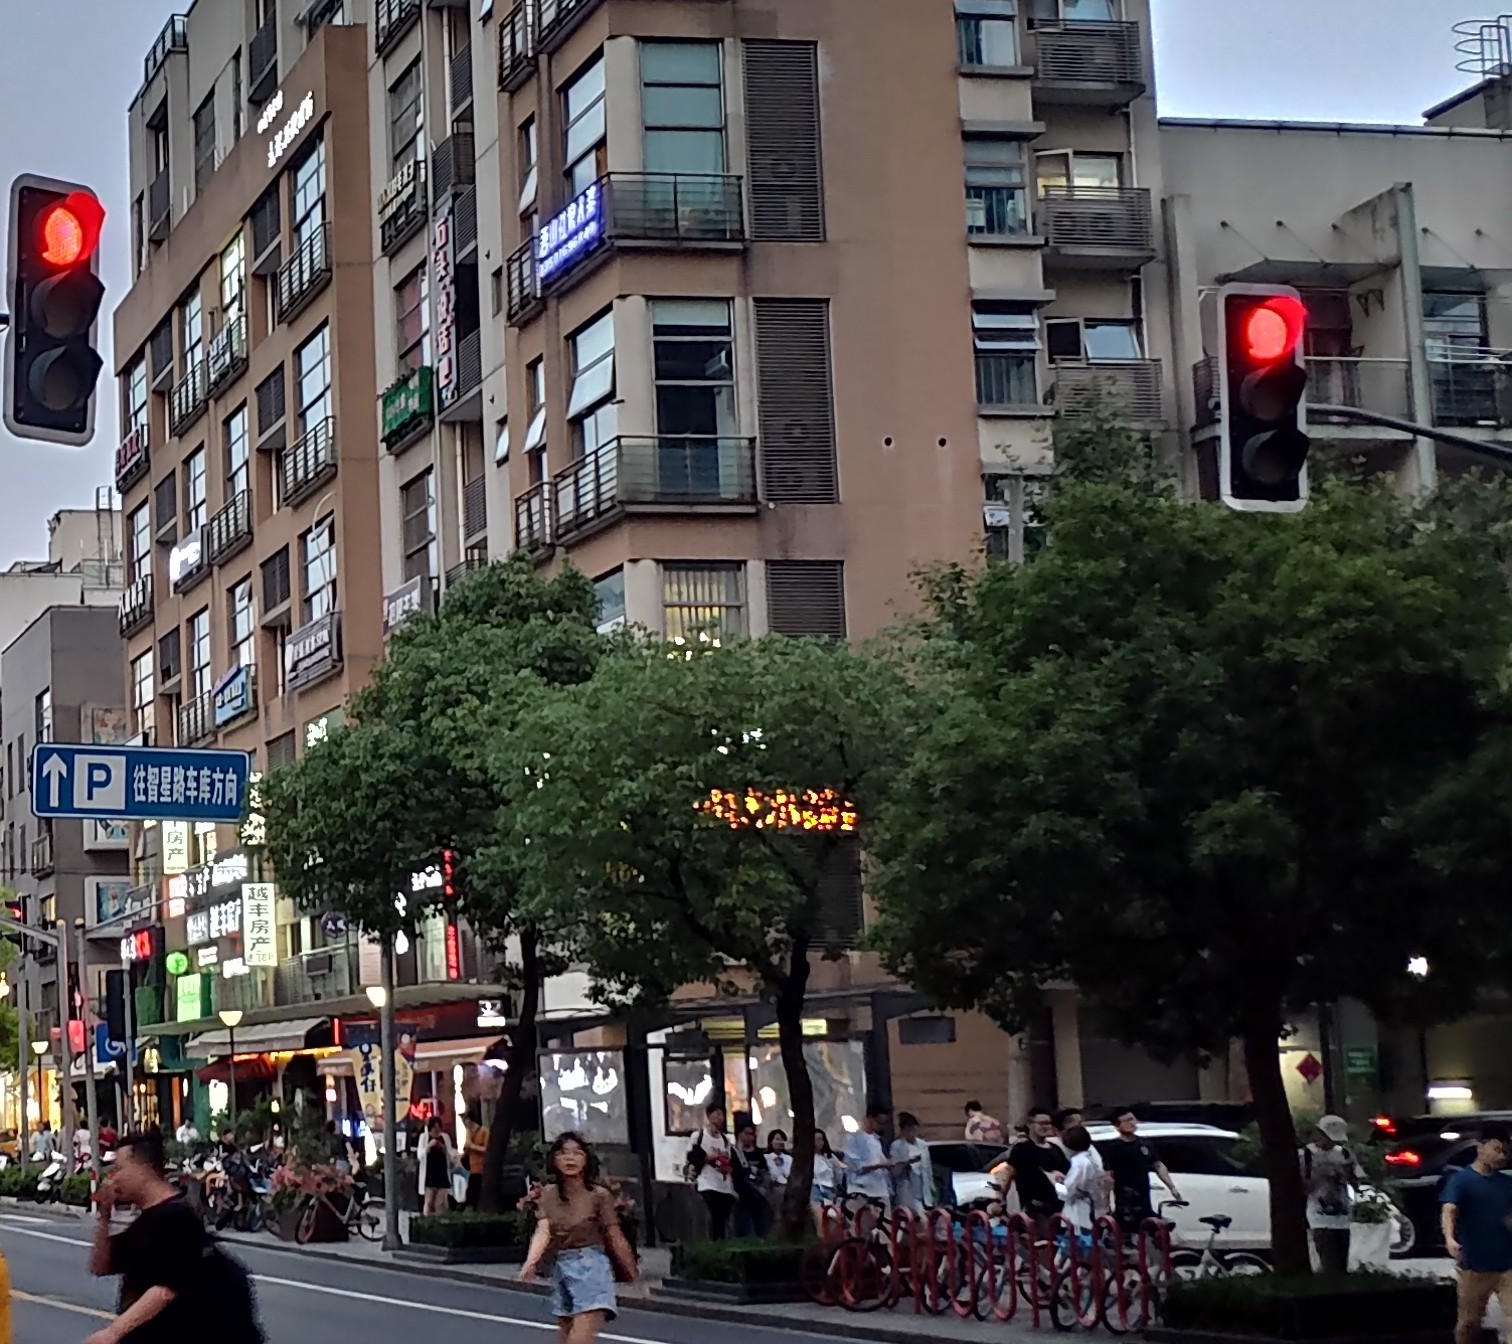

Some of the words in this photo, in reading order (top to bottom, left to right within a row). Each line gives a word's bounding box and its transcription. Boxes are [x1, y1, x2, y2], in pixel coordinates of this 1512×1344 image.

[87, 762, 113, 801] P
[133, 764, 238, 806] 往智星路车库方向
[167, 820, 185, 861] 房产
[248, 886, 271, 952] 越丰房产
